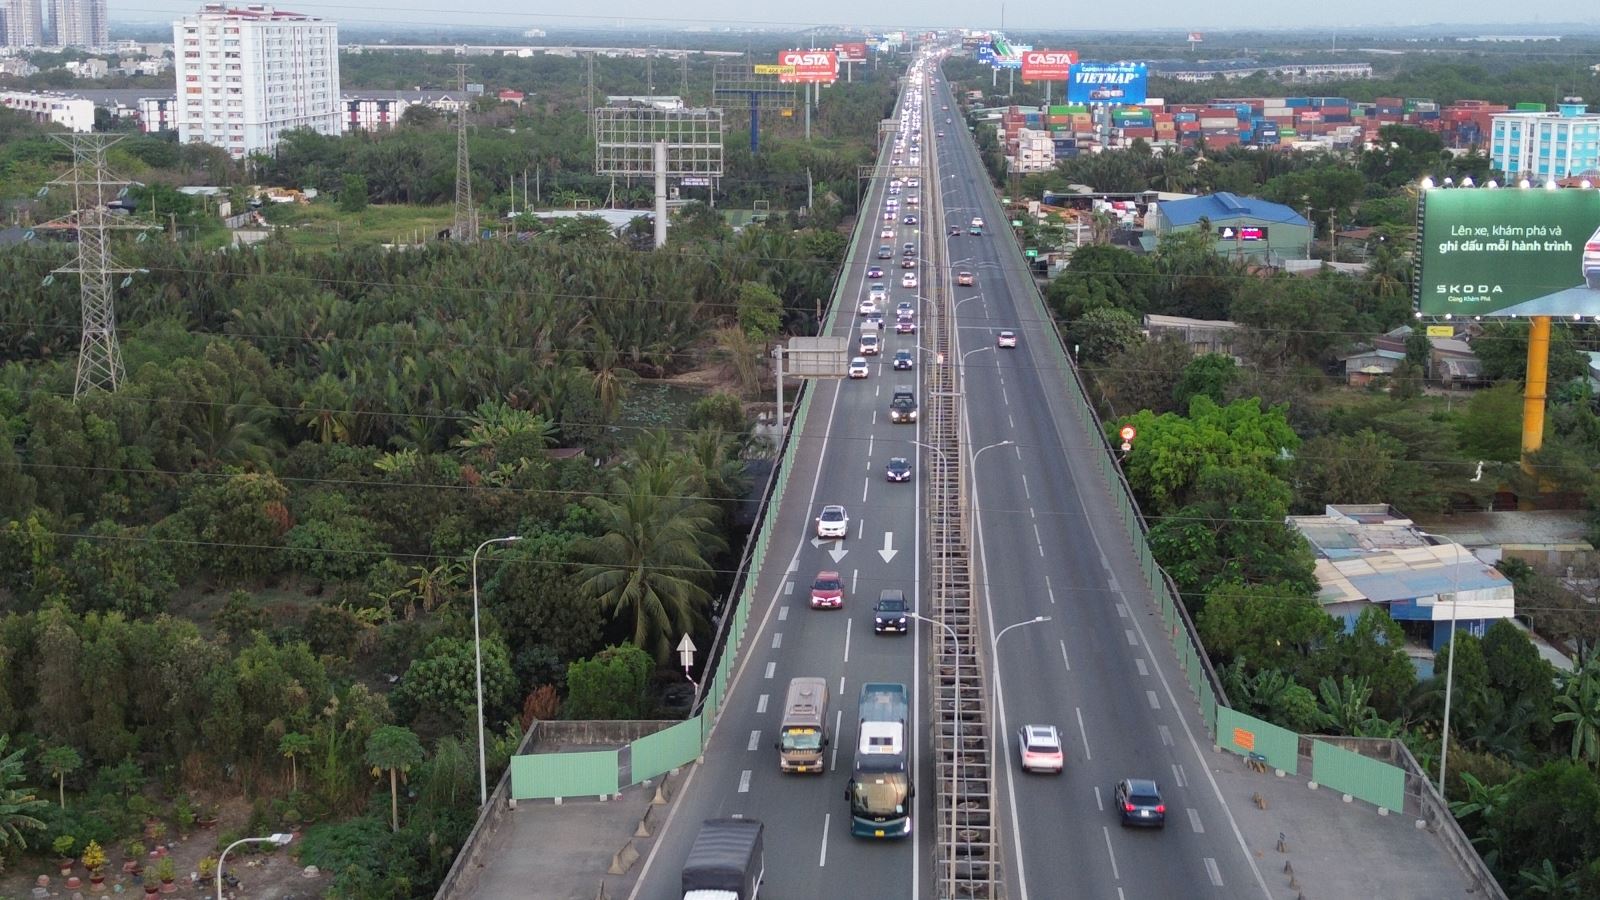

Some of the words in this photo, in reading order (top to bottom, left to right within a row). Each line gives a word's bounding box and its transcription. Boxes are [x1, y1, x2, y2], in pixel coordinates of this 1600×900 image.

[784, 54, 829, 65] CASTA
[1027, 53, 1072, 64] CASTA
[1075, 73, 1134, 83] VIETMAP
[1451, 225, 1472, 236] Lên
[1474, 226, 1489, 237] xe,
[1492, 225, 1523, 236] khám
[1526, 225, 1546, 238] phá
[1549, 225, 1562, 236] và
[1439, 240, 1458, 253] ghi
[1460, 239, 1483, 251] dấu
[1486, 238, 1509, 251] mỗi
[1511, 240, 1541, 251] hành
[1544, 240, 1572, 251] trình
[1436, 284, 1503, 293] SKODA
